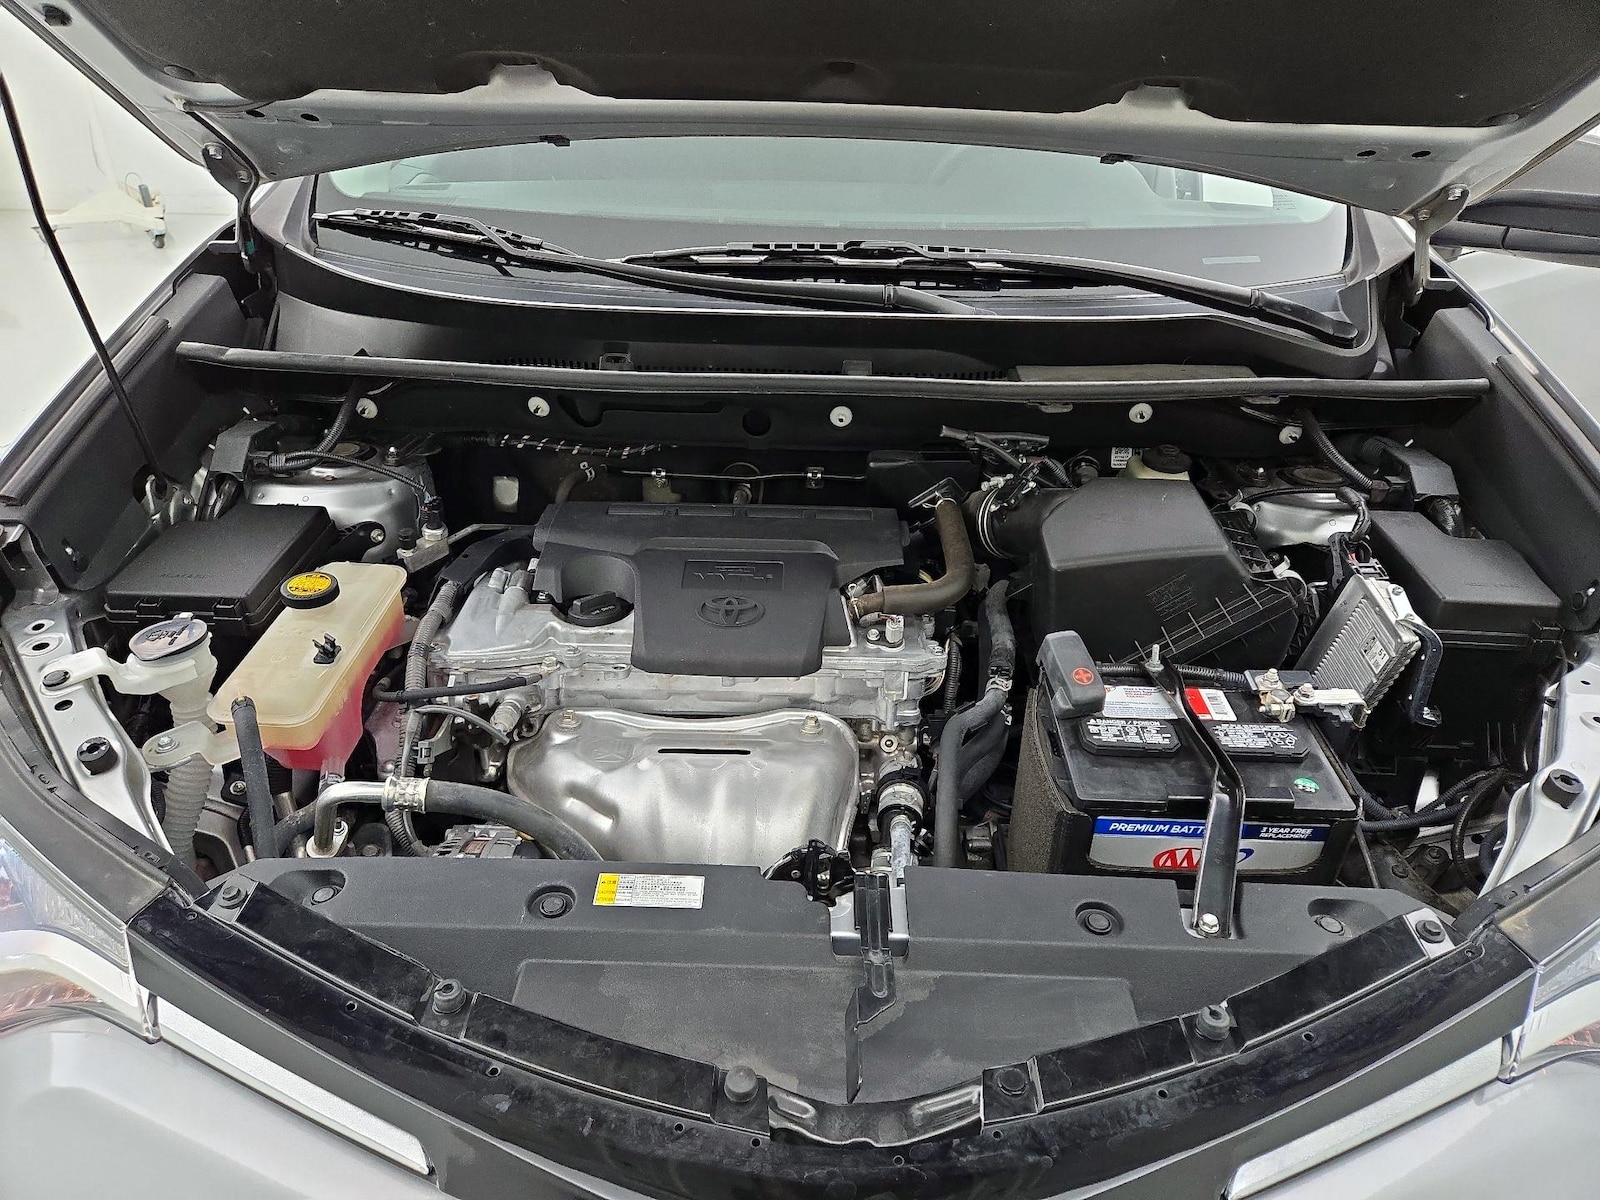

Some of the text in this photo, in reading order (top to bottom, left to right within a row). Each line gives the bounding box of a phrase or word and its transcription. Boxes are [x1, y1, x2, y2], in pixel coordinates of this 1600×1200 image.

[1109, 822, 1206, 834] PREMIUM BATT
[1153, 846, 1202, 869] AA
